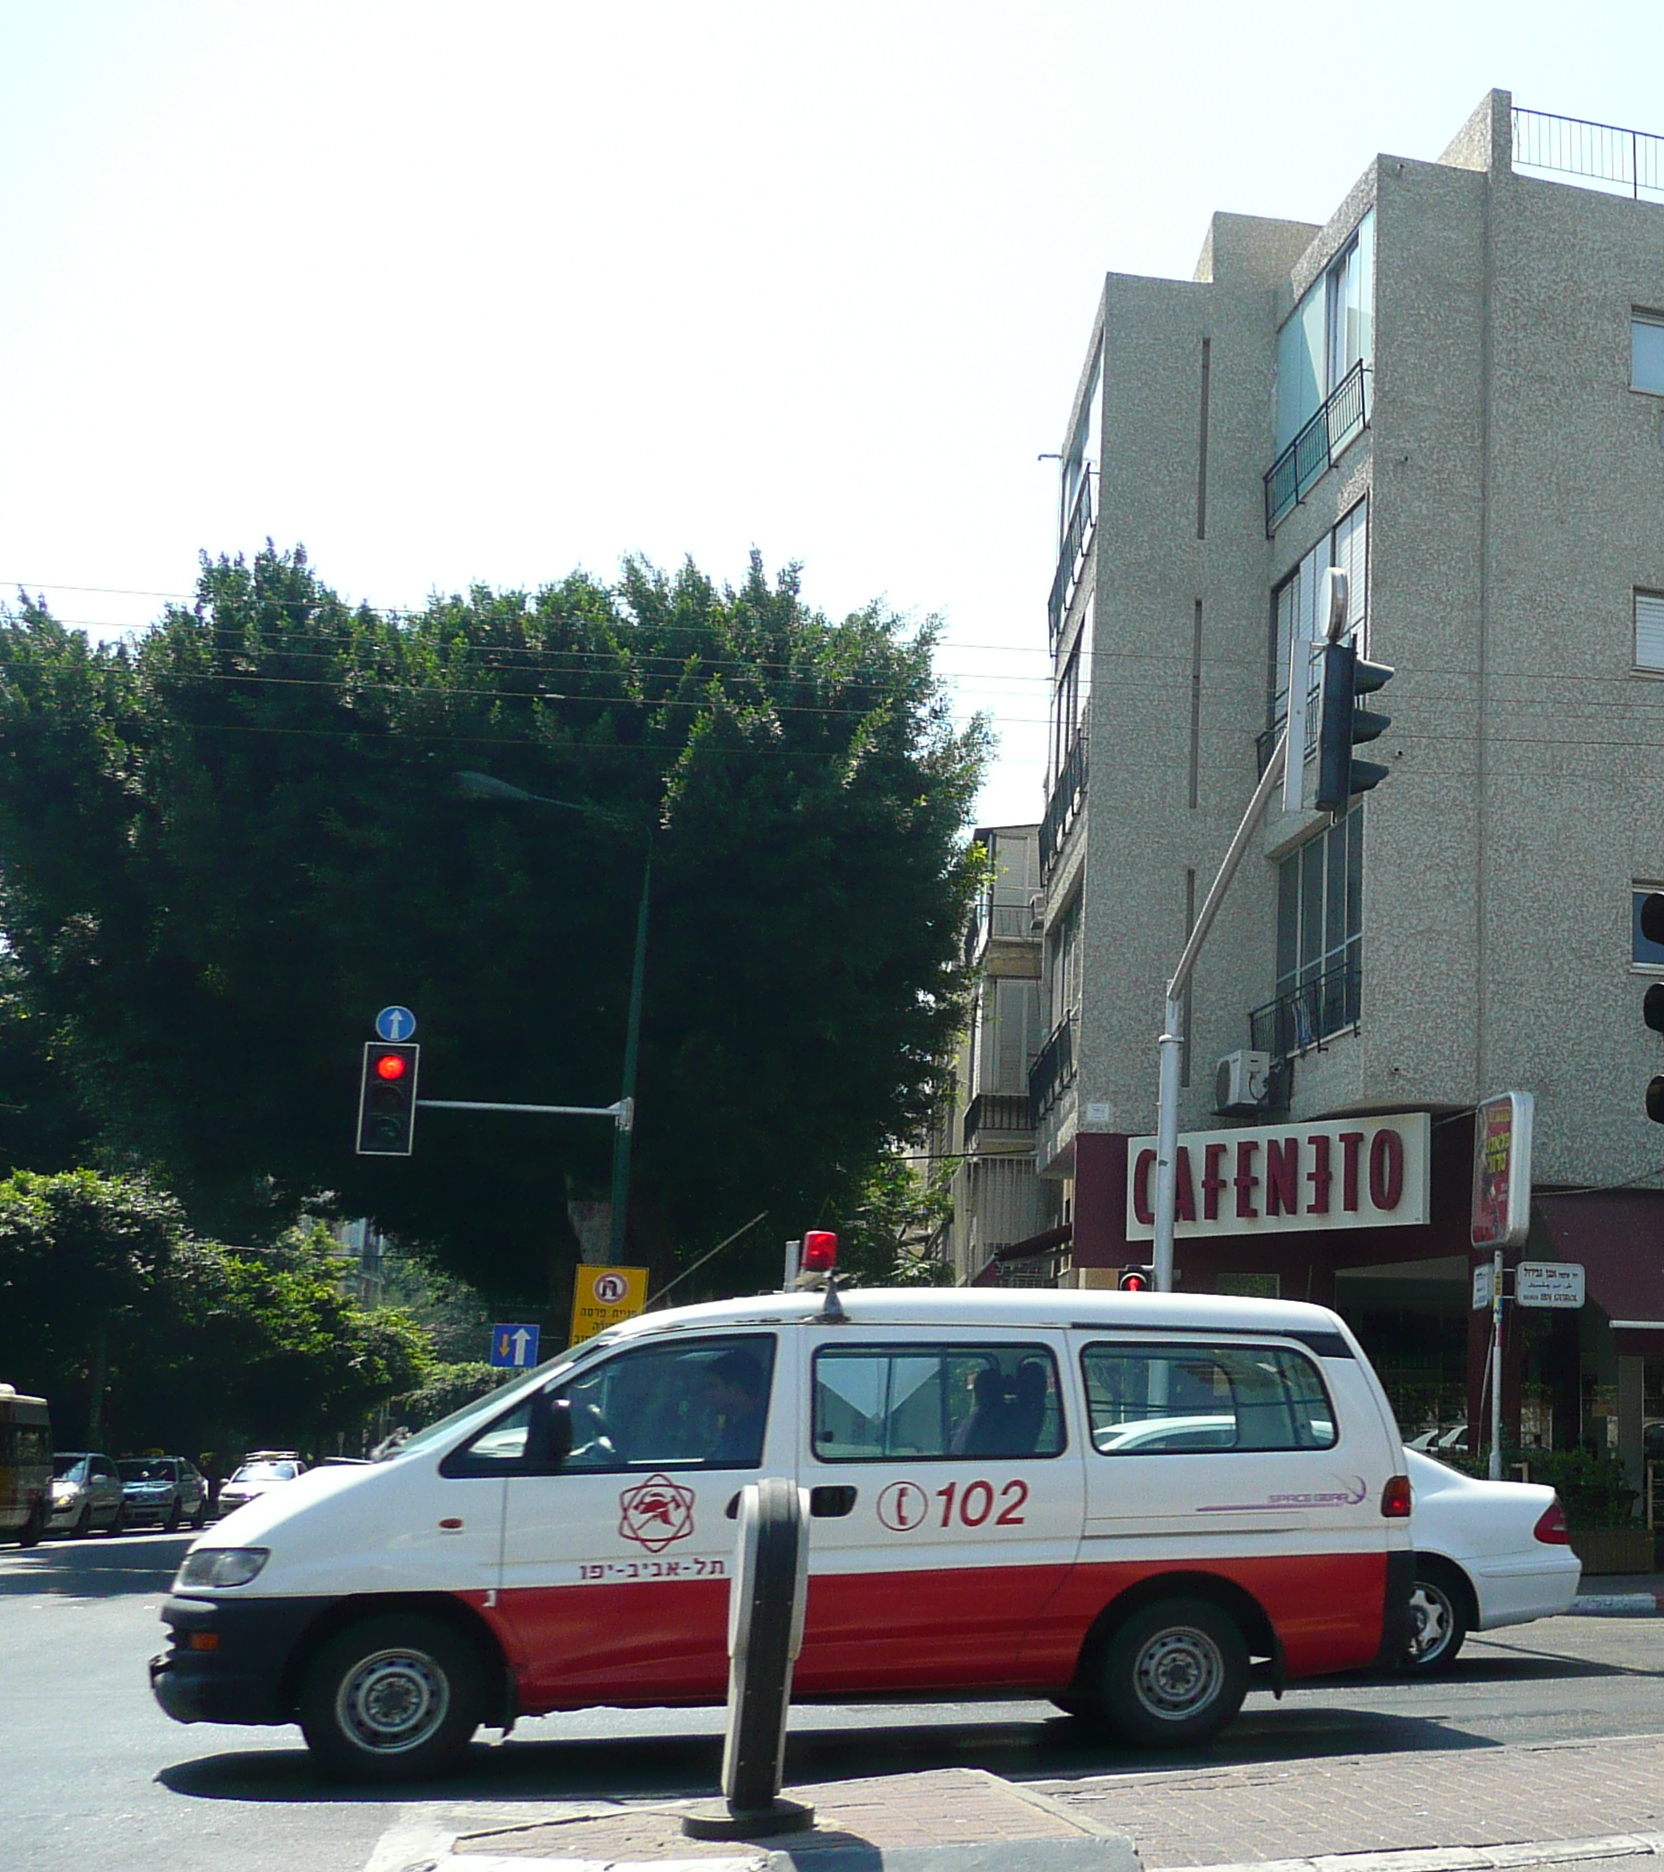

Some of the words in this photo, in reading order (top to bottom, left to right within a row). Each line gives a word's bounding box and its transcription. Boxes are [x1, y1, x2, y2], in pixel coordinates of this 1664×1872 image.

[936, 1479, 1029, 1528] 102
[1268, 1493, 1312, 1504] SPACE
[579, 1558, 726, 1580] תל-אביב-יפו
